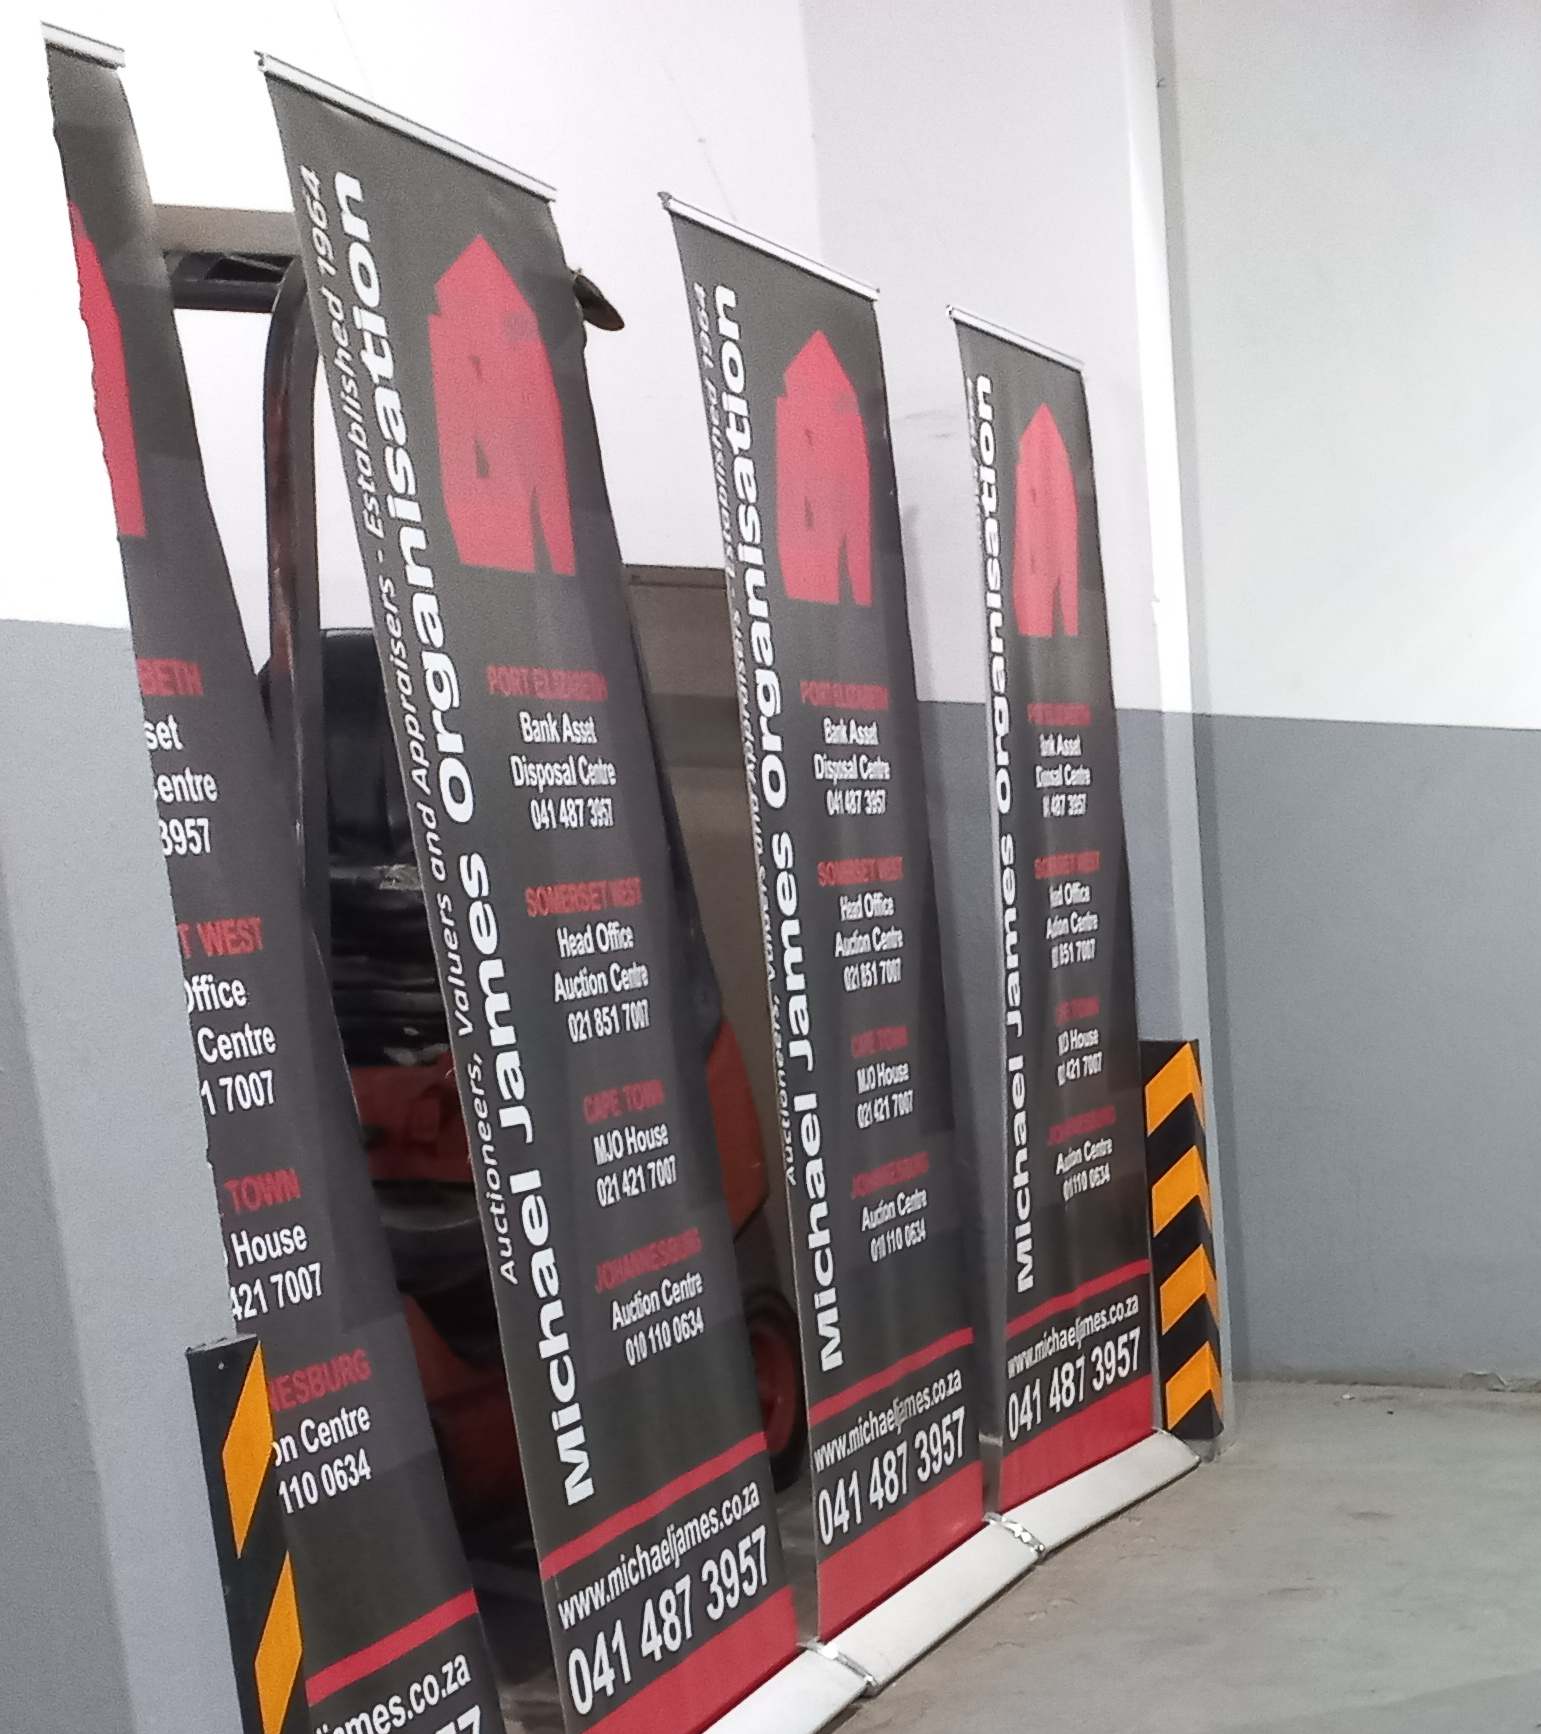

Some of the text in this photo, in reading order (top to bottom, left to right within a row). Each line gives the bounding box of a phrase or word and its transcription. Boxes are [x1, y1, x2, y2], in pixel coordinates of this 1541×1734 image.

[299, 164, 336, 278] 1964
[320, 290, 385, 541] Established
[377, 575, 431, 795] Appraisers
[519, 711, 560, 745] Bank
[155, 766, 218, 803] entre
[510, 755, 577, 793] Disposal
[159, 818, 212, 856] 3957
[334, 171, 595, 1507] Michael James Organisation
[417, 802, 446, 878] and
[530, 798, 556, 830] 041
[558, 798, 584, 828] 487
[713, 284, 845, 1372] Michael James Organisation
[976, 375, 1035, 1294] Michael James Organisation
[197, 917, 264, 956] WEST
[440, 893, 475, 1037] Valuers
[556, 920, 634, 960] Head Office
[553, 964, 609, 1003] Auction
[197, 1023, 277, 1064] Centre
[567, 1008, 594, 1044] 021
[594, 1003, 621, 1037] 851
[201, 1069, 275, 1116] 1 7007
[467, 1052, 518, 1284] Auctioneers,
[625, 1122, 670, 1161] House
[223, 1169, 302, 1213] TOWN
[596, 1172, 620, 1208] 021
[622, 1163, 646, 1198] 421
[230, 1223, 308, 1268] House
[229, 1262, 324, 1321] 421 7007
[611, 1270, 704, 1332] Auction Centre
[625, 1306, 705, 1368] 010 110 0634
[1008, 1327, 1142, 1441] 041 487 3957
[300, 1404, 372, 1456] Centre
[813, 1367, 962, 1473] www.michaeljames.co.za
[278, 1447, 372, 1516] 110 0634
[817, 1406, 967, 1547] 041 487 3957
[557, 1480, 760, 1631] www.michaeljames.co.za
[566, 1524, 771, 1716] 041 487 3957
